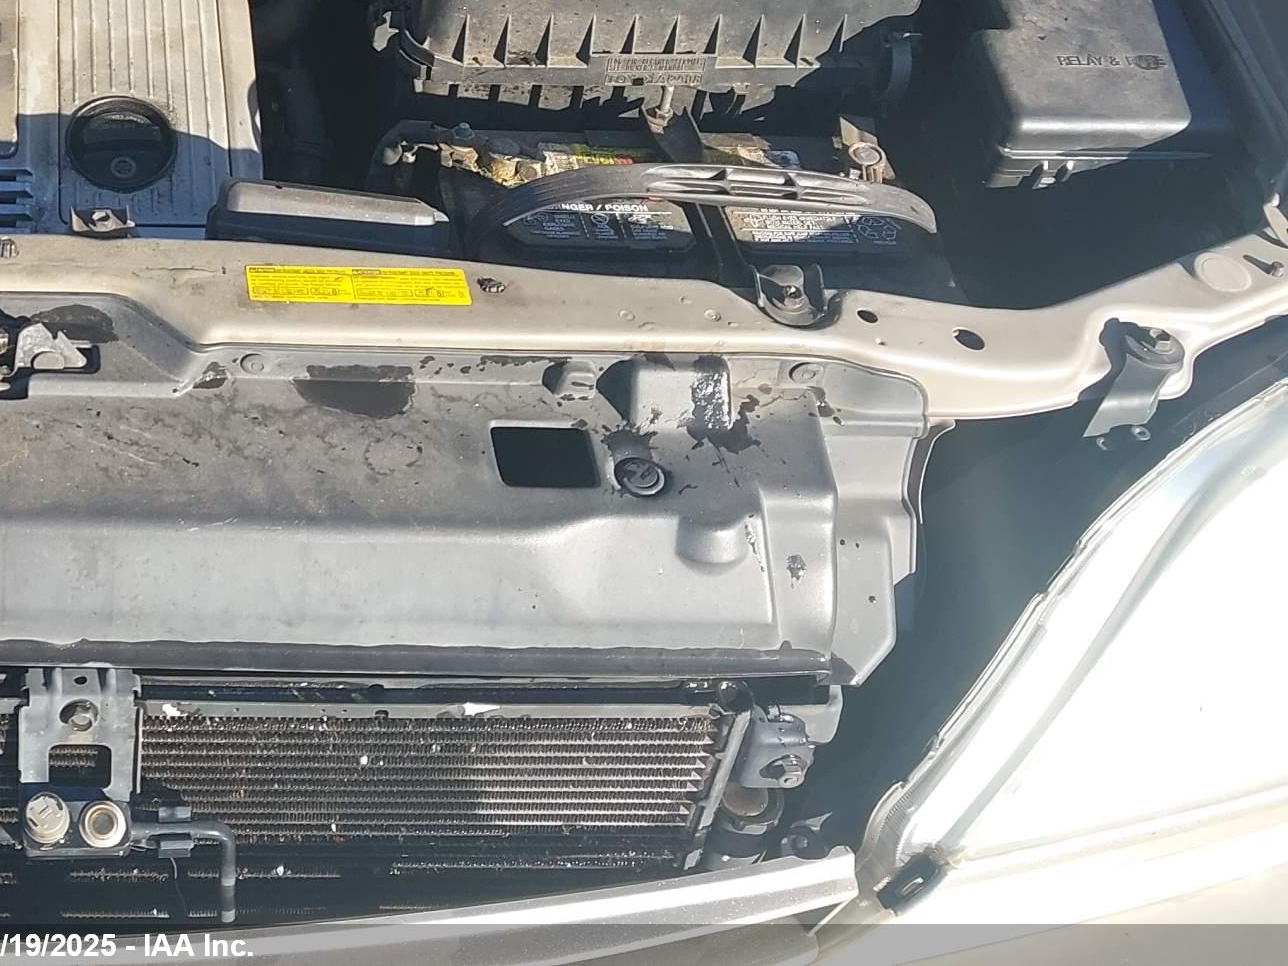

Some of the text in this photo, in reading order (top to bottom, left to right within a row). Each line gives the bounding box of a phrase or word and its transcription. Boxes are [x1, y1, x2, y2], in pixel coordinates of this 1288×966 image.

[1056, 55, 1103, 66] RELAY
[1109, 55, 1121, 66] &
[604, 203, 649, 212] POISON
